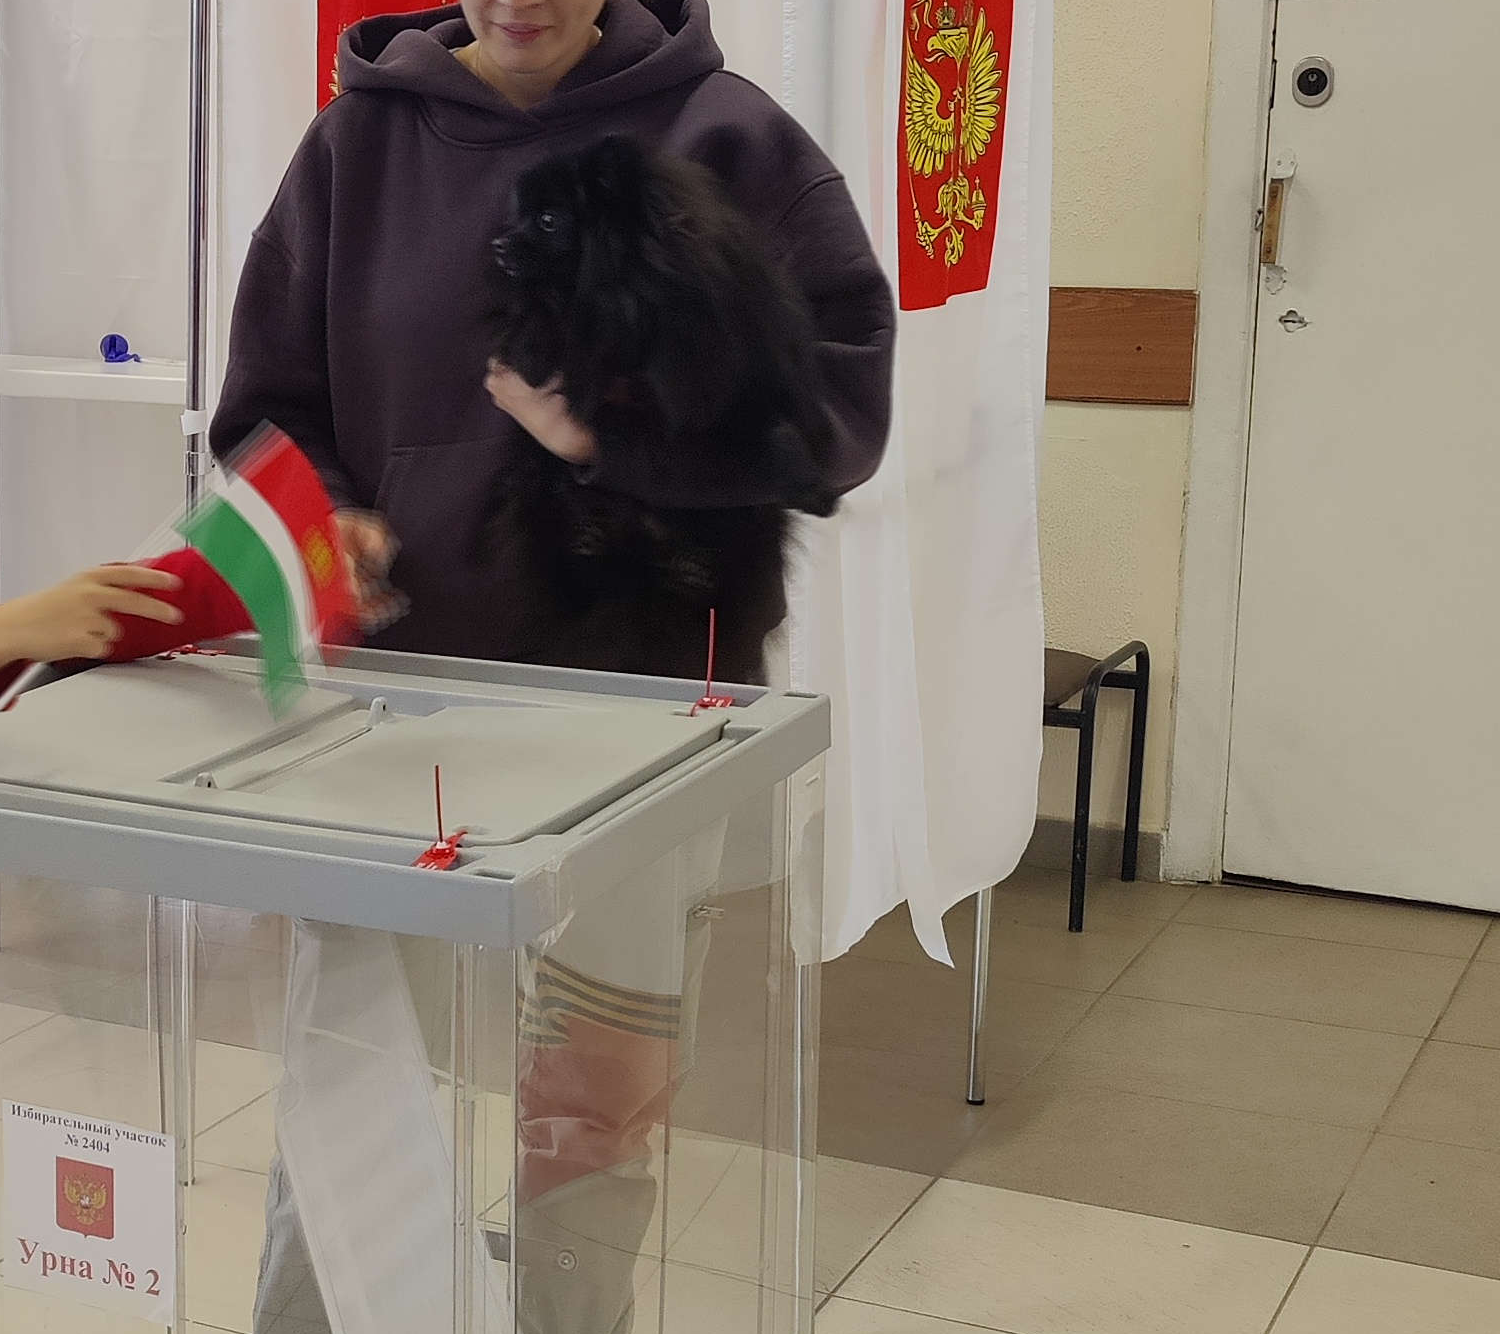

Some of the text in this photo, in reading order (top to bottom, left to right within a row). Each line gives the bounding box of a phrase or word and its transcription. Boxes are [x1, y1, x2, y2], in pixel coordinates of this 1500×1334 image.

[11, 1104, 167, 1148] Избирательный участок
[64, 1133, 110, 1153] № 2404
[16, 1236, 161, 1296] Урна № 2
